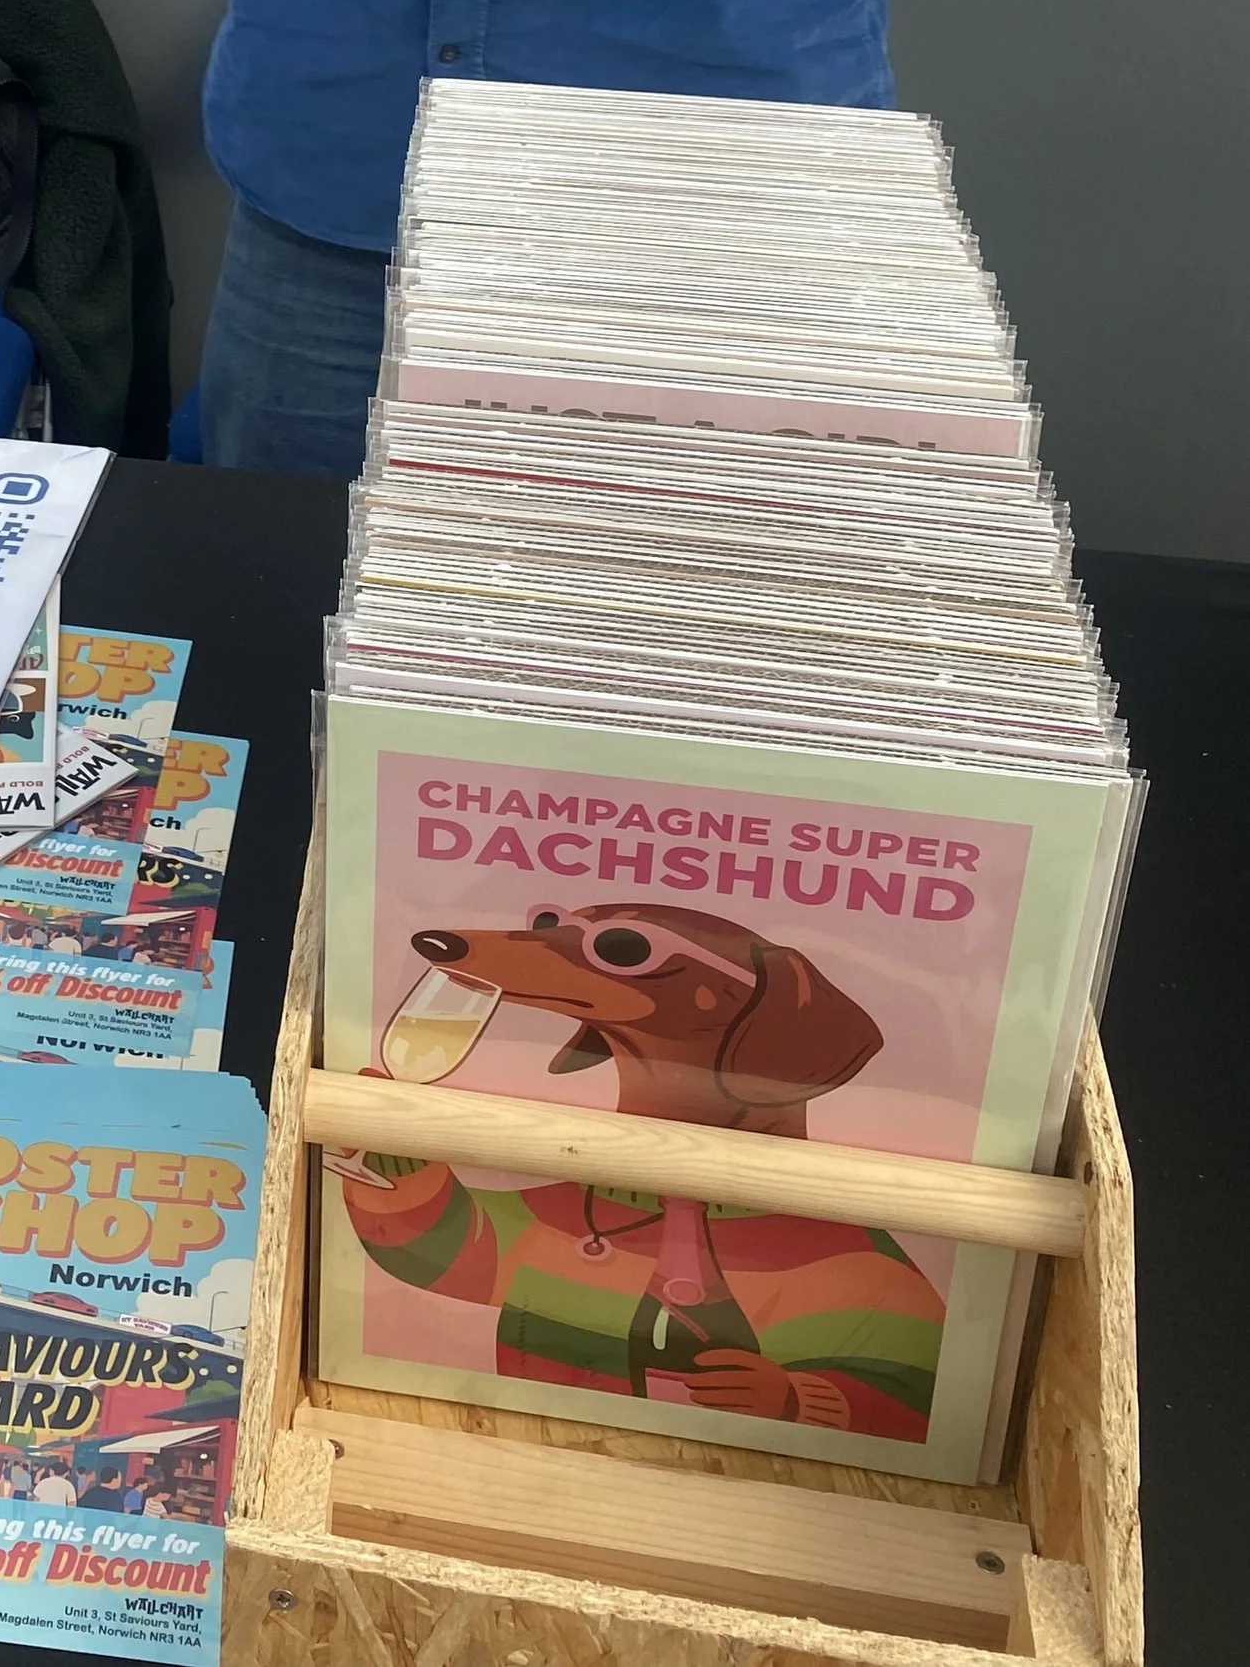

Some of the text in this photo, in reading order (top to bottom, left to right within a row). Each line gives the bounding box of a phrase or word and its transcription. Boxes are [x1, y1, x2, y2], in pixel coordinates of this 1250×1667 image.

[417, 779, 980, 872] CHAMPAGNE SUPER
[417, 816, 975, 923] DACHSHUND
[49, 1264, 192, 1298] Norwich
[33, 1519, 86, 1542] this
[92, 1525, 155, 1552] flyer
[162, 1533, 200, 1555] for
[46, 1543, 211, 1594] Discount
[65, 1606, 201, 1634] Unit 3, St Saviours Yard,
[125, 1598, 203, 1620] WALLCHART
[57, 1620, 94, 1634] Street,
[99, 1625, 146, 1641] Norwich
[150, 1631, 174, 1644] NR3
[177, 1635, 201, 1648] 1AA
